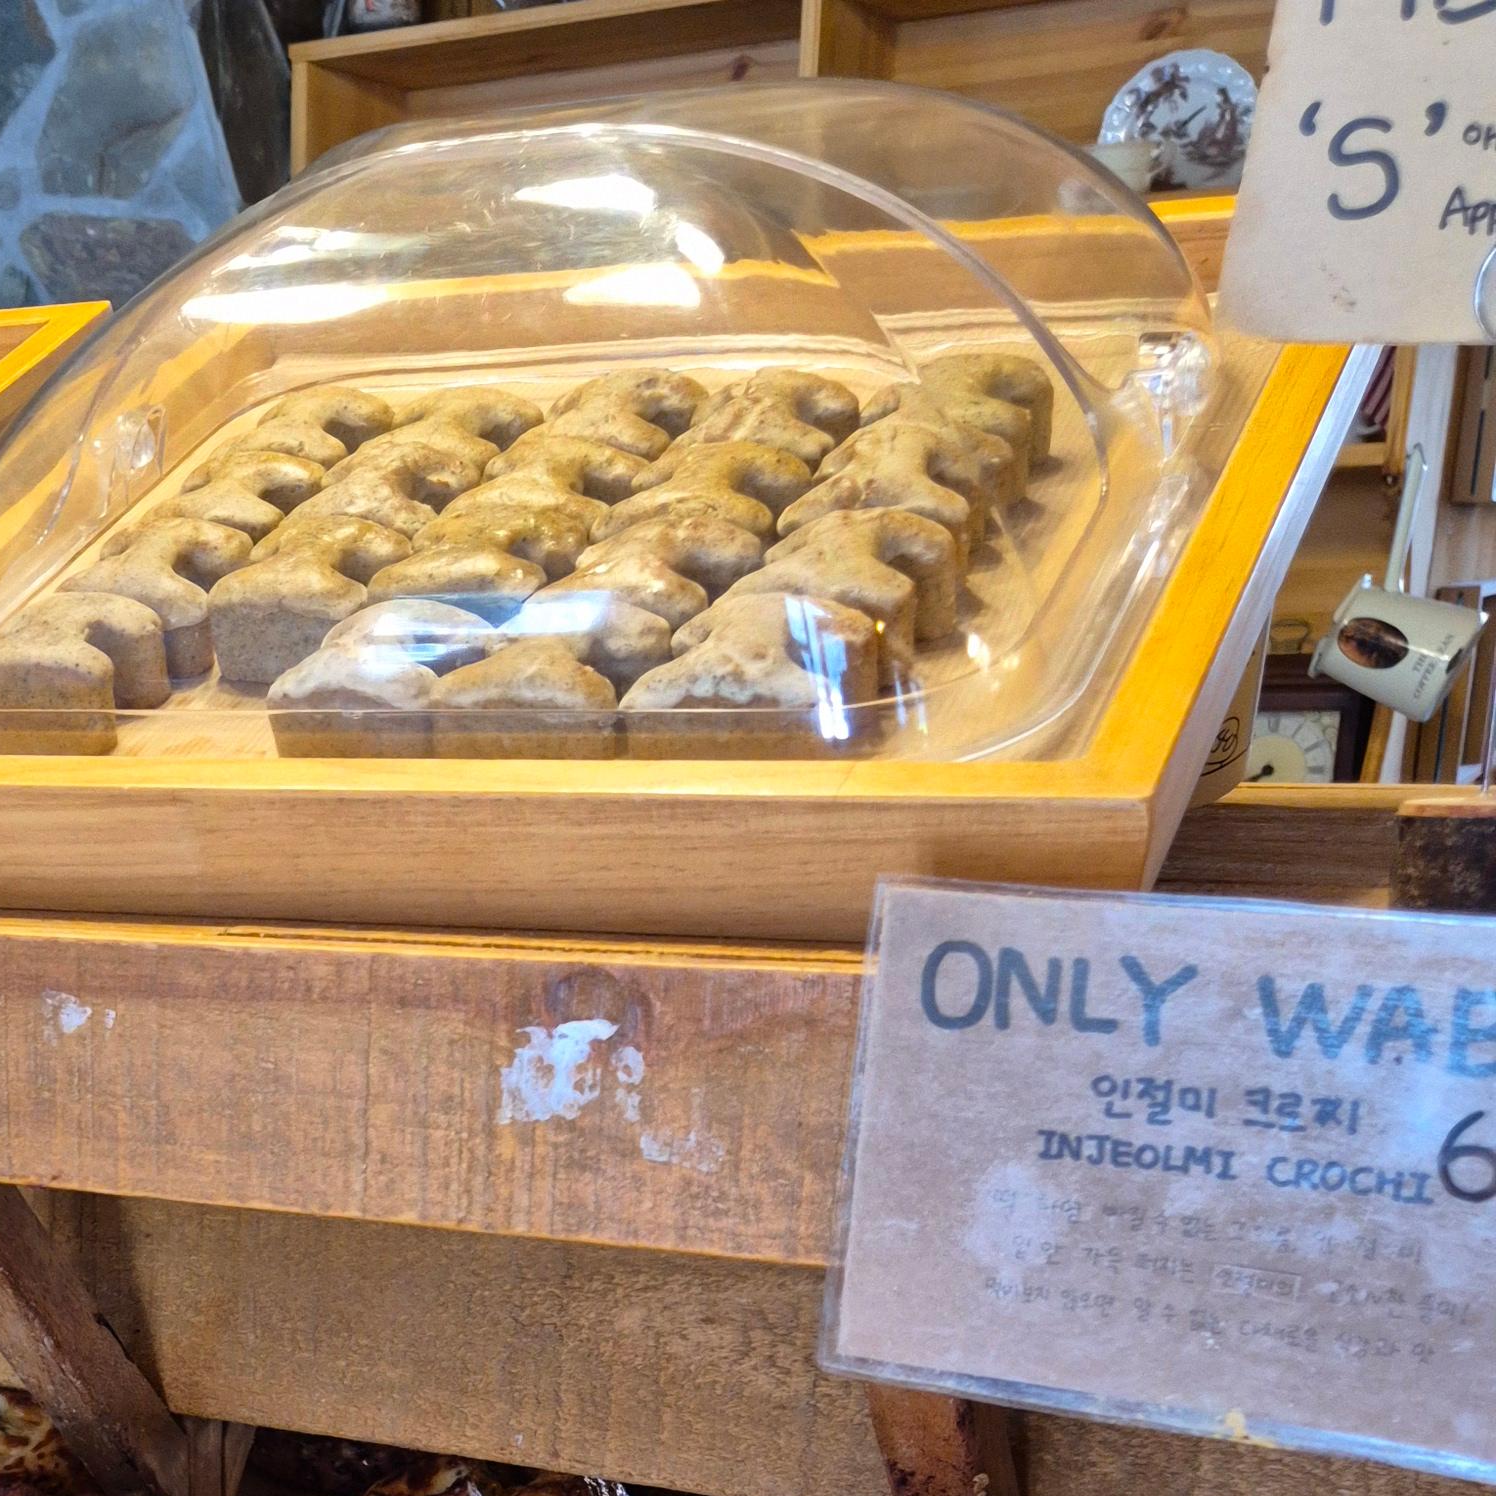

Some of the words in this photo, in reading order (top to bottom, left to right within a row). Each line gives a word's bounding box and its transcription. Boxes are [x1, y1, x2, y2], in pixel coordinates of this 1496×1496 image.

[920, 940, 1198, 1046] ONLY
[1091, 1074, 1218, 1126] 인절미
[1037, 1129, 1238, 1179] INJEOLMI
[1265, 1156, 1434, 1205] CROCHI
